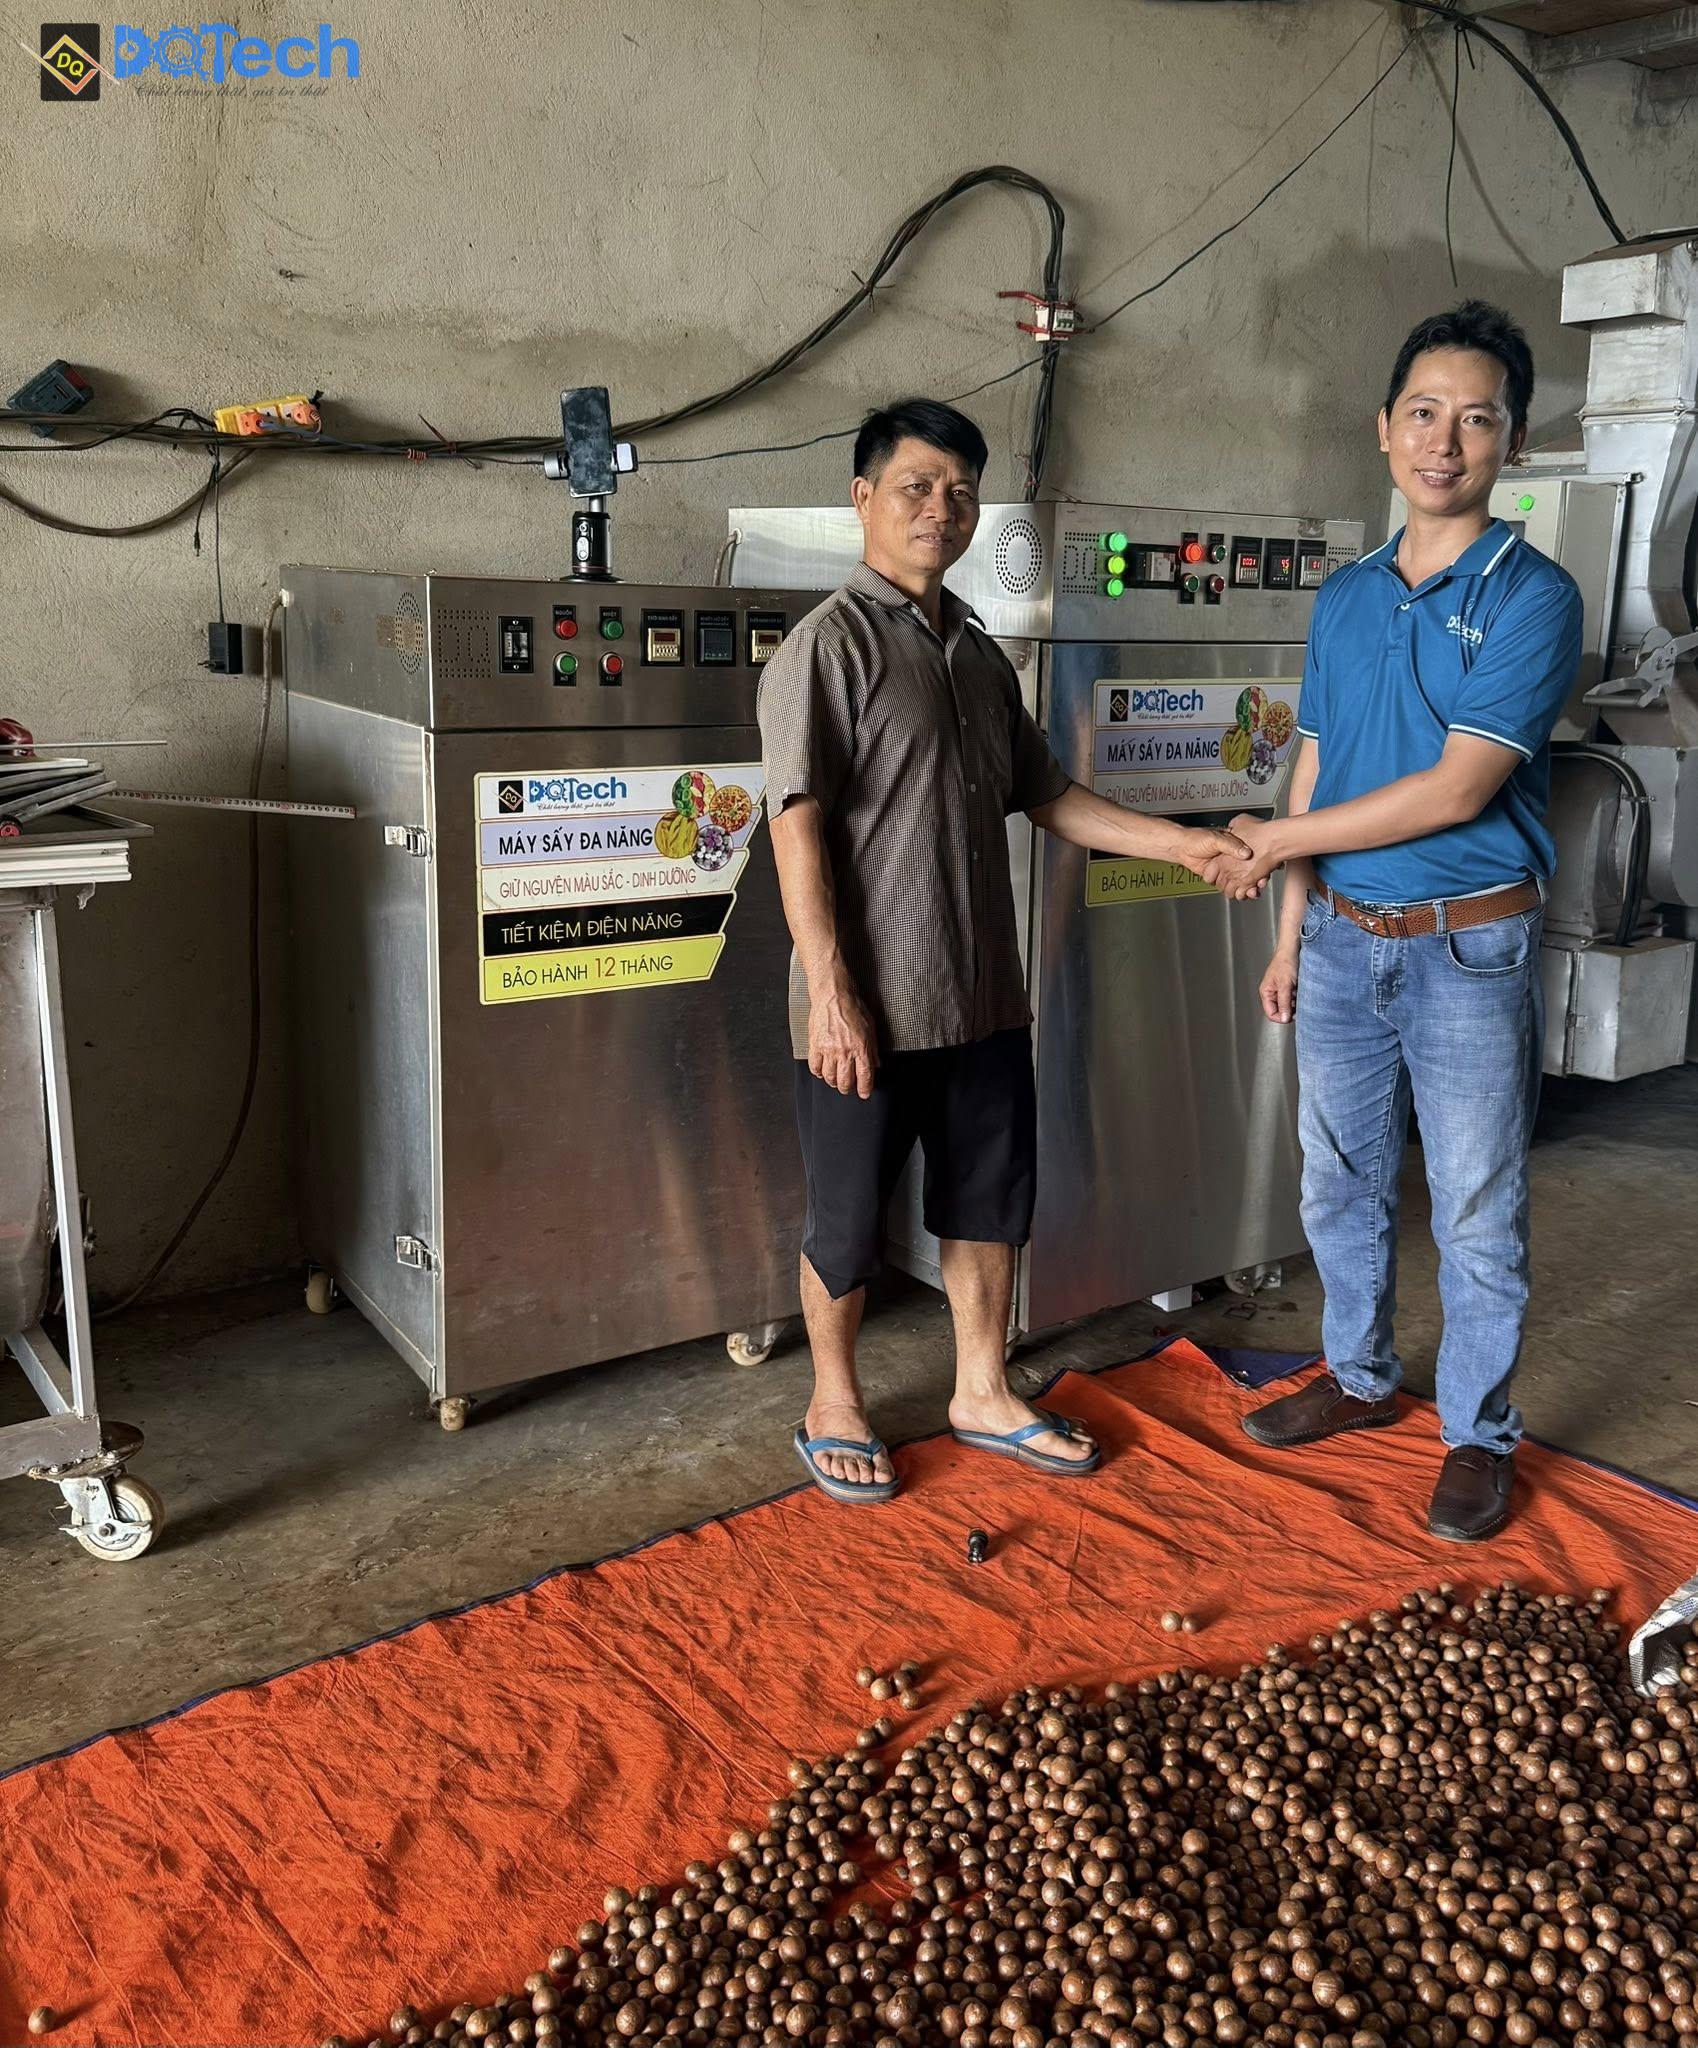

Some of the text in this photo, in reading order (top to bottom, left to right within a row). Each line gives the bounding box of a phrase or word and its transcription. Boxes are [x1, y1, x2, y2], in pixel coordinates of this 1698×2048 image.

[1107, 735, 1220, 762] MÁY SẤY ĐA NĂNG
[529, 776, 628, 803] DQTech
[1201, 783, 1219, 799] DINH
[499, 825, 653, 856] MÁY SẤY ĐA NĂNG
[499, 878, 521, 898] GIỮ
[523, 875, 571, 896] NGUYÊN
[574, 872, 600, 893] MÀU
[602, 868, 623, 890] SẮC
[632, 872, 656, 888] DINH
[659, 867, 697, 886] DƯỠNG
[1101, 870, 1127, 892] BẢO
[1130, 867, 1164, 889] HÀNH
[1170, 864, 1185, 885] 12
[501, 912, 683, 945] TIẾT KIỆM ĐIỆN NĂNG
[502, 954, 673, 988] BẢO HÀNH 12 THÁNG
